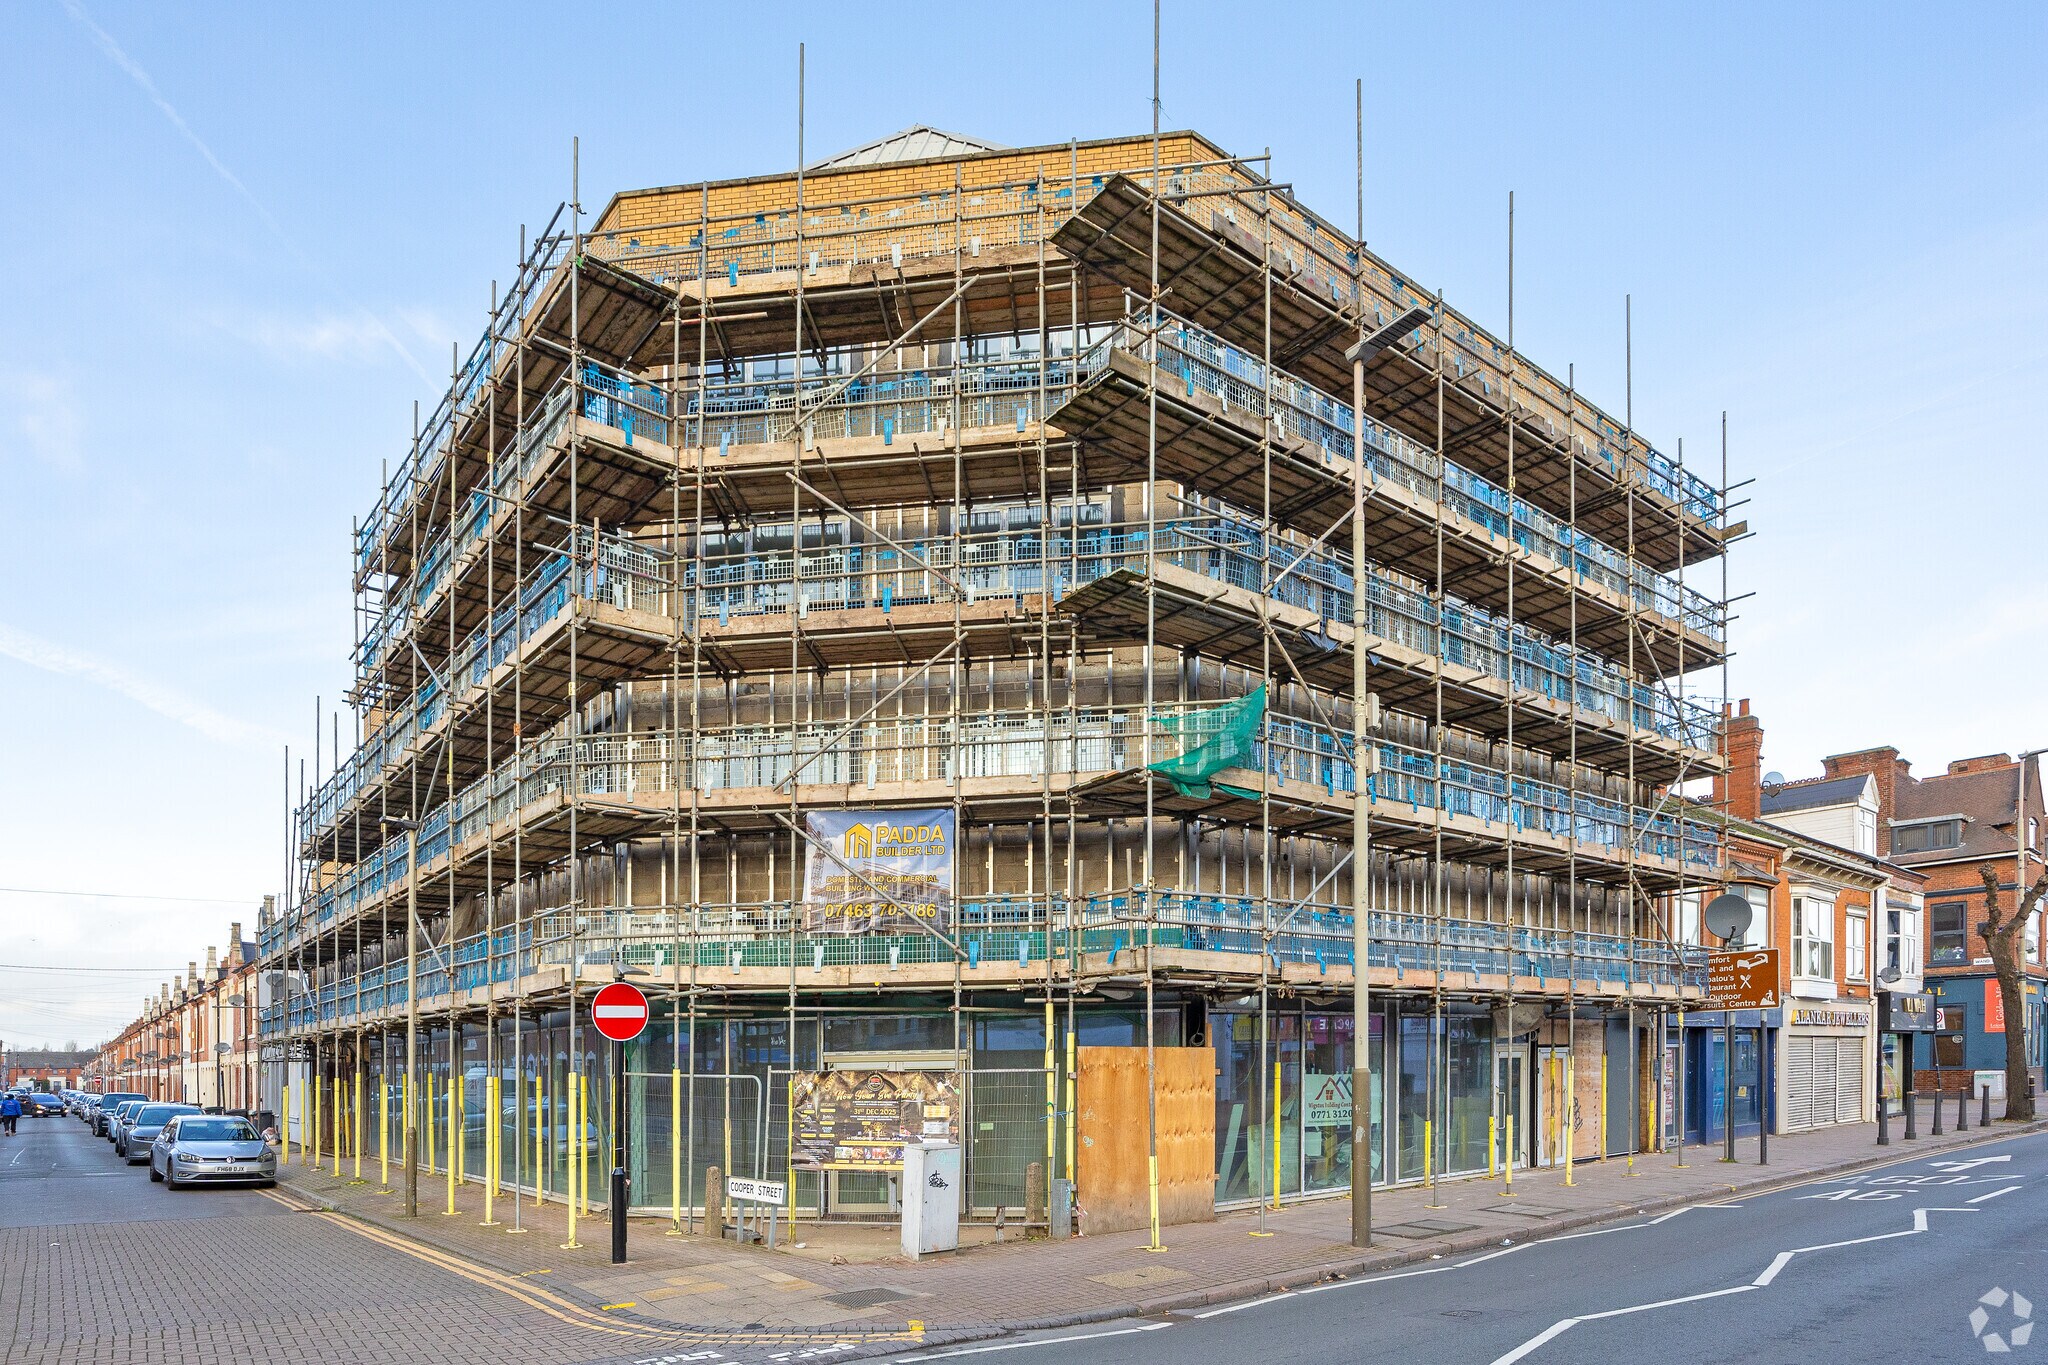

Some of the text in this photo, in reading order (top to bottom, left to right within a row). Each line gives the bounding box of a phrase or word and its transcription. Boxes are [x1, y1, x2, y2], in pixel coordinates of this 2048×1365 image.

[876, 824, 945, 844] PADDA
[876, 845, 945, 857] BUILDER LTD
[886, 875, 938, 883] COMMERCIAL
[826, 884, 861, 892] BUILDING
[825, 902, 873, 918] 07463
[1709, 993, 1741, 1001] Outdoor
[1729, 999, 1756, 1008] Centre
[1792, 1009, 1869, 1027] ALANKAR JEWELLERS
[1311, 1109, 1352, 1119] 0771 3120
[730, 1182, 783, 1198] COOPER STREET
[1792, 1188, 1919, 1201] A6
